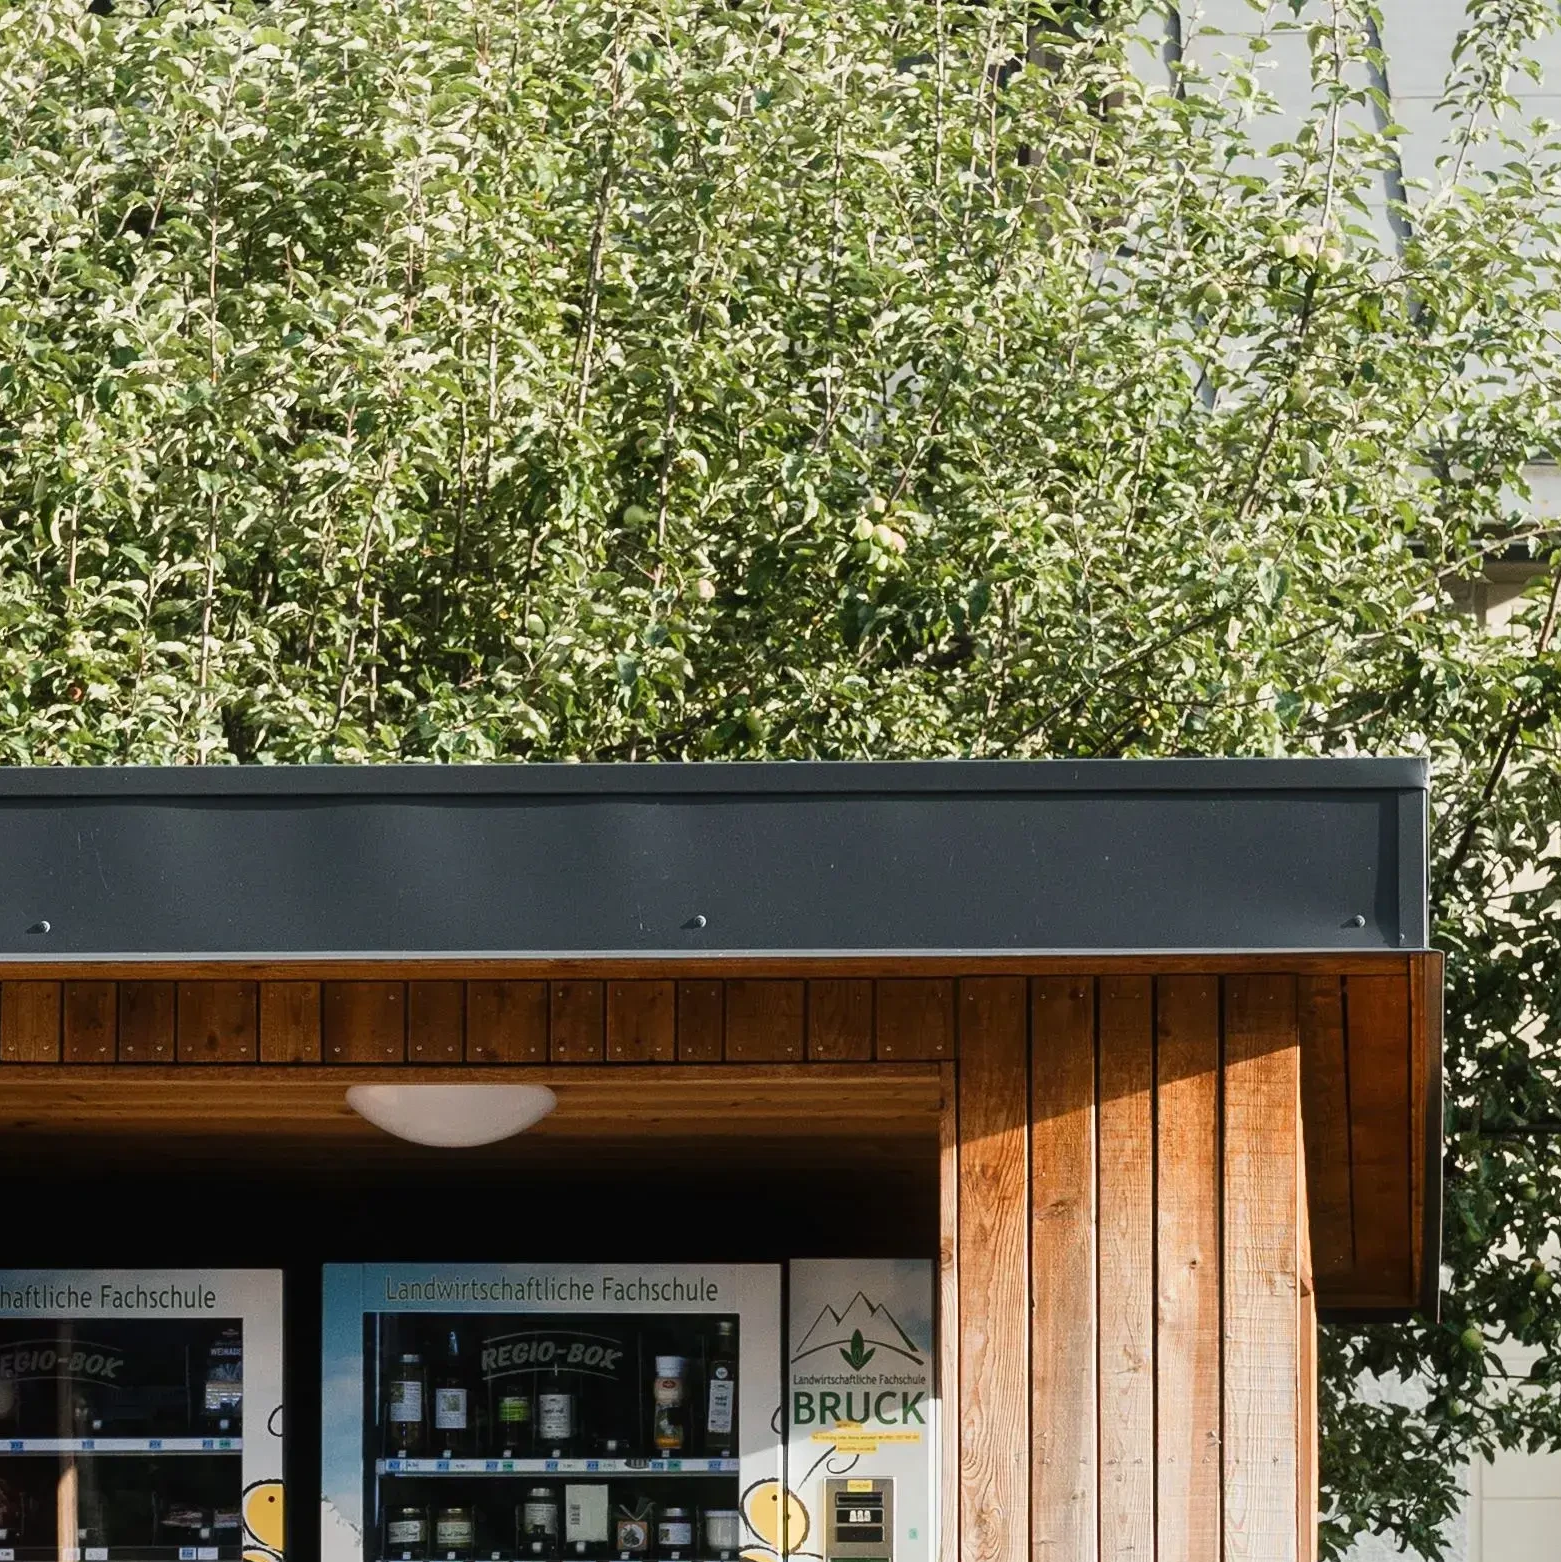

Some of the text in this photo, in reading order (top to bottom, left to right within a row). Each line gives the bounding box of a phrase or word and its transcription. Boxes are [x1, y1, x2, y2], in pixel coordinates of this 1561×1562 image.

[101, 1284, 216, 1309] Fachschule
[387, 1276, 719, 1301] Landwirtschaftliche Fachschule
[481, 1341, 624, 1371] REGIO-BOX
[793, 1374, 926, 1385] Landwirtschaftliche Fachschule
[793, 1391, 926, 1424] BRUCK
